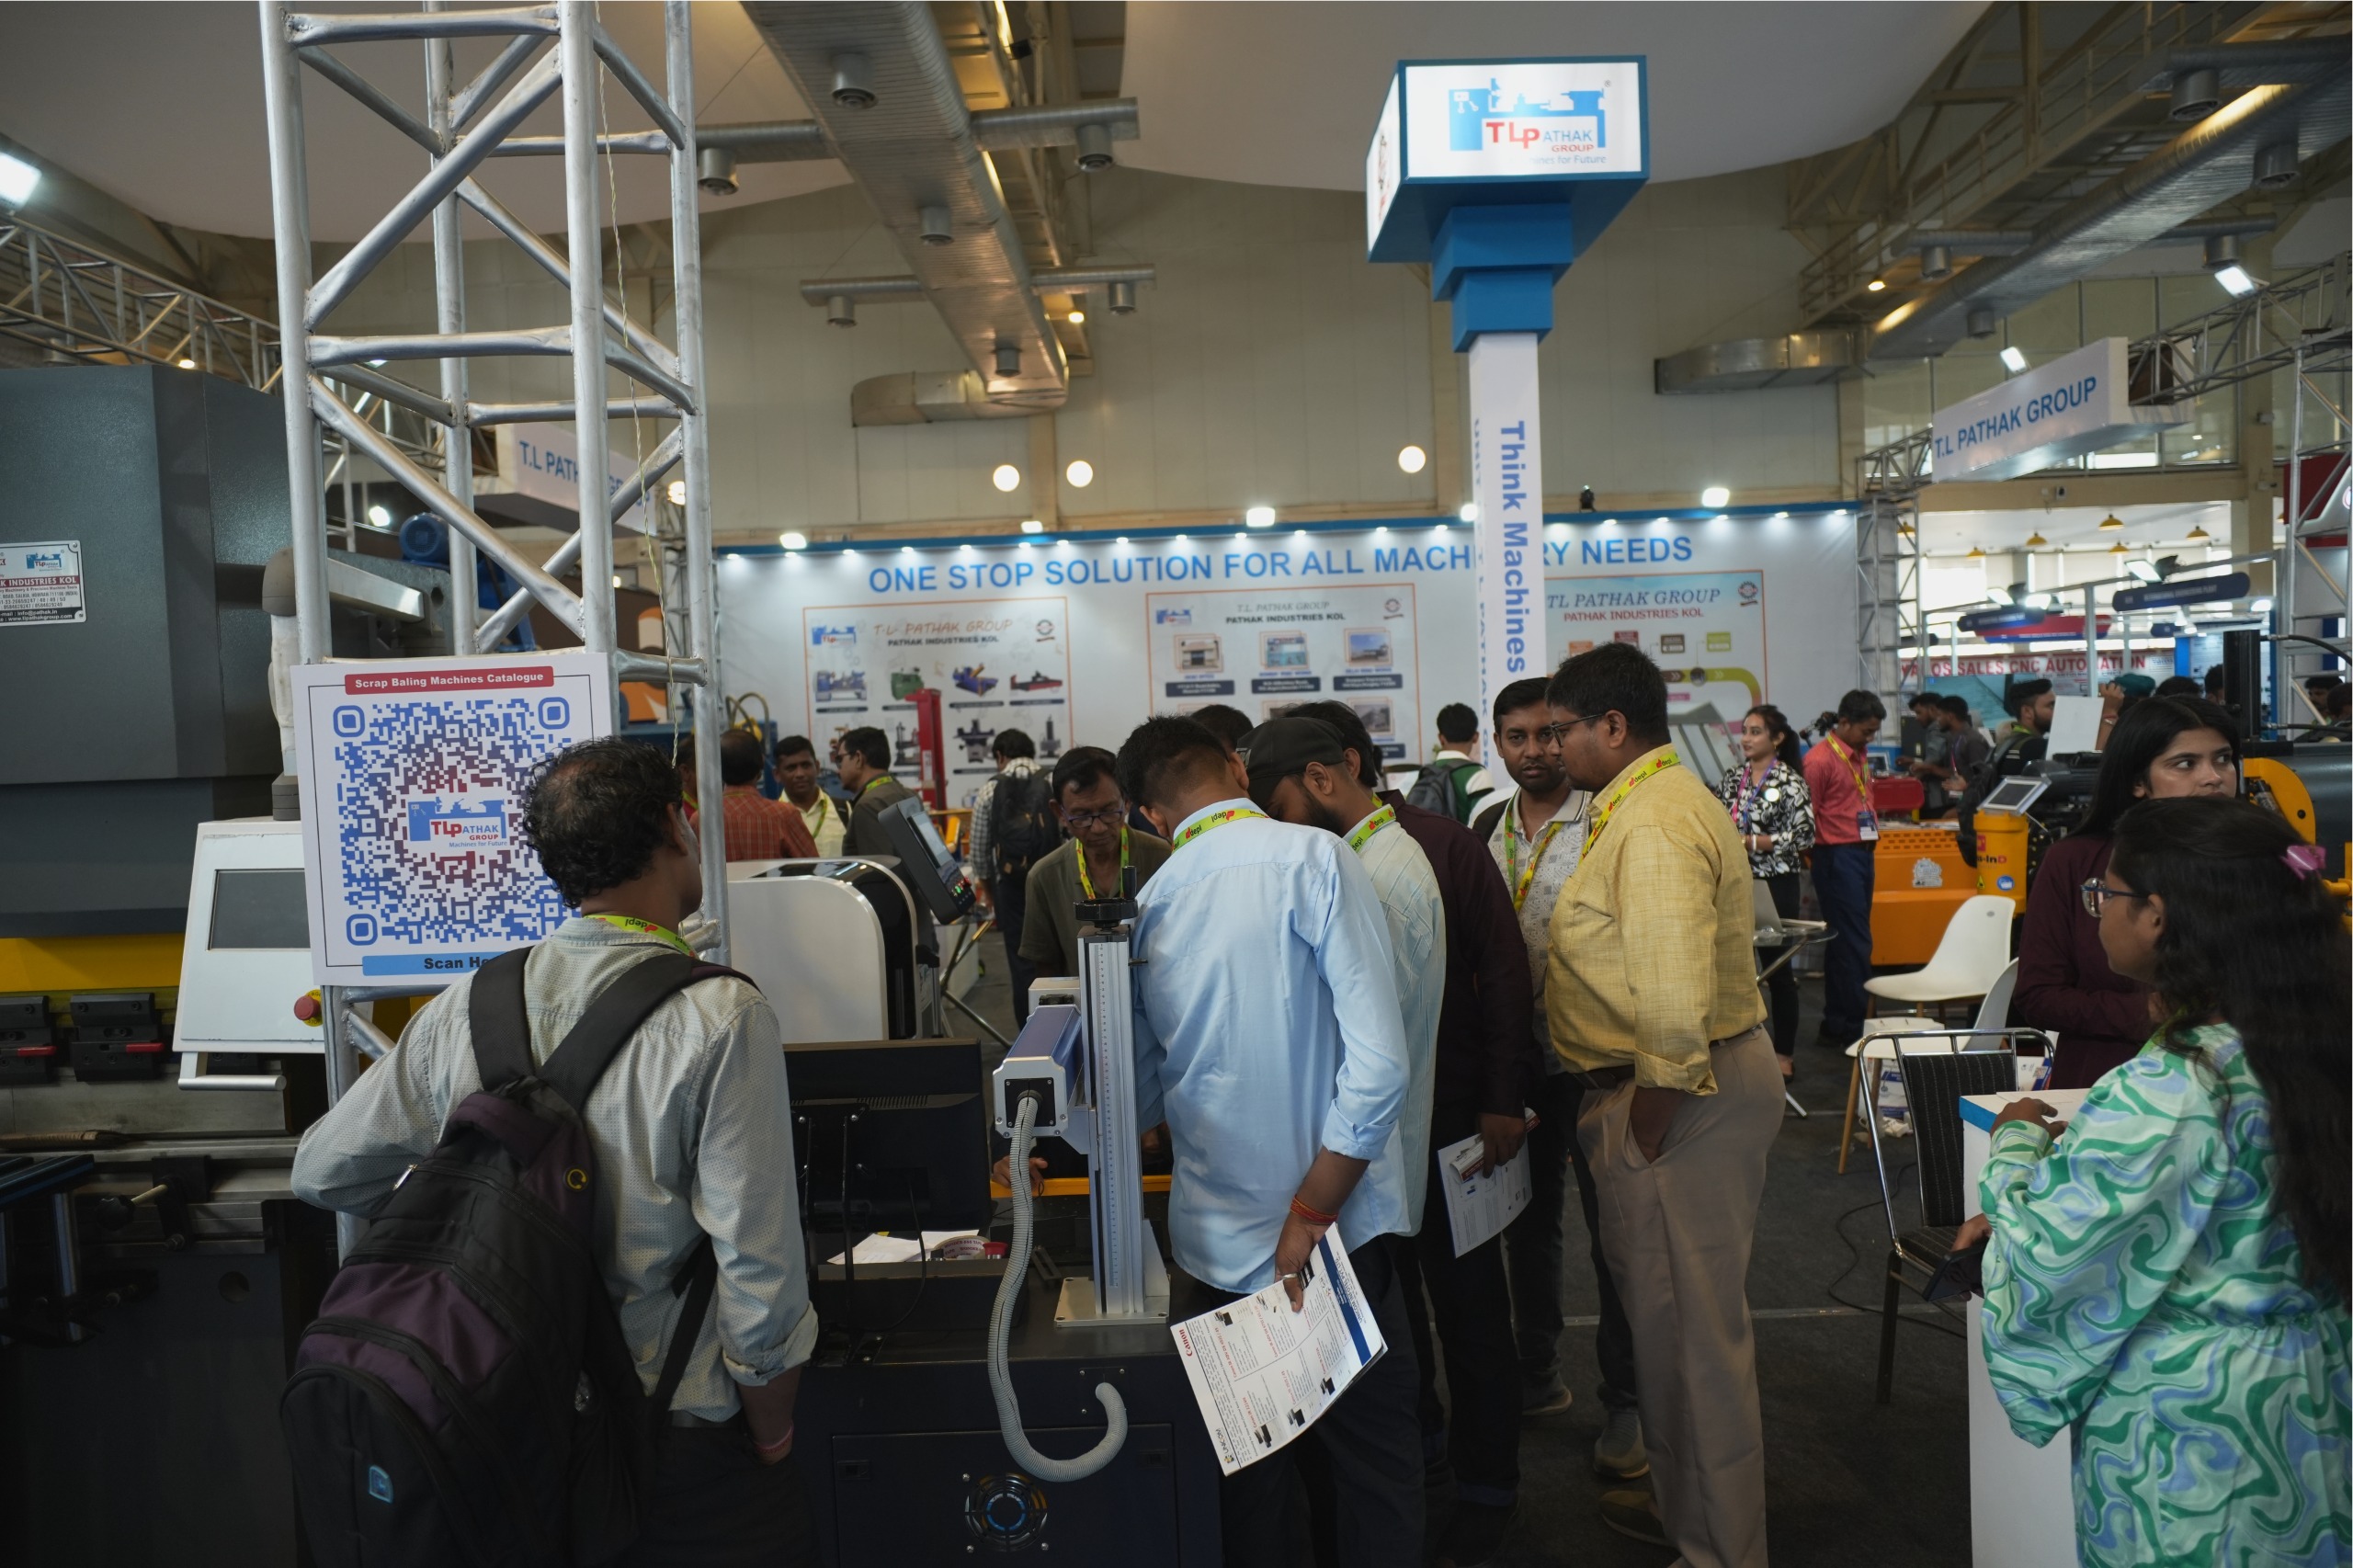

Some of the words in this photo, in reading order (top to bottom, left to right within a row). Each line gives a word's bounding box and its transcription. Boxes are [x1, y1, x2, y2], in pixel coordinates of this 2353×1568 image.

[1552, 143, 1594, 153] GROUP
[1574, 154, 1607, 165] Future
[1958, 405, 2022, 450] PATHAK
[2027, 376, 2097, 423] GROUP
[1500, 420, 1526, 510] Think
[869, 566, 938, 593] ONE
[949, 562, 1034, 590] STOP
[1045, 554, 1212, 585] SOLUTION
[1224, 551, 1291, 580] FOR
[1301, 549, 1365, 576] ALL
[1583, 537, 1693, 565] NEEDS
[9, 577, 56, 585] INDUSTRIES
[1503, 522, 1529, 674] Machines
[1574, 592, 1650, 608] PATHAK
[1654, 588, 1721, 605] GROUP
[1256, 603, 1293, 612] PATHAK
[1297, 601, 1330, 611] GROUP
[1226, 616, 1264, 624] PATHAK
[1267, 614, 1324, 622] INDUSTRIES
[1564, 611, 1607, 622] PATHAK
[1610, 608, 1679, 620] INDUSTRIES
[1682, 608, 1704, 618] KOL
[904, 622, 960, 634] PATHAK
[966, 619, 1013, 632] GROUP
[925, 637, 979, 645] INDUSTRIES
[1958, 659, 2004, 676] SALES
[2009, 657, 2040, 673] CNC
[355, 678, 388, 689] Scrap
[392, 677, 427, 687] Baling
[430, 676, 483, 686] Machines
[487, 674, 544, 684] Catalogue
[1662, 758, 1672, 767] depl
[1634, 771, 1647, 783] depl
[1190, 824, 1202, 836] depl
[625, 918, 648, 928] depl
[424, 958, 463, 970] Scan
[1342, 1278, 1354, 1301] INFOTEL
[1351, 1300, 1363, 1324] UNICOM
[1179, 1328, 1193, 1357] Canon
